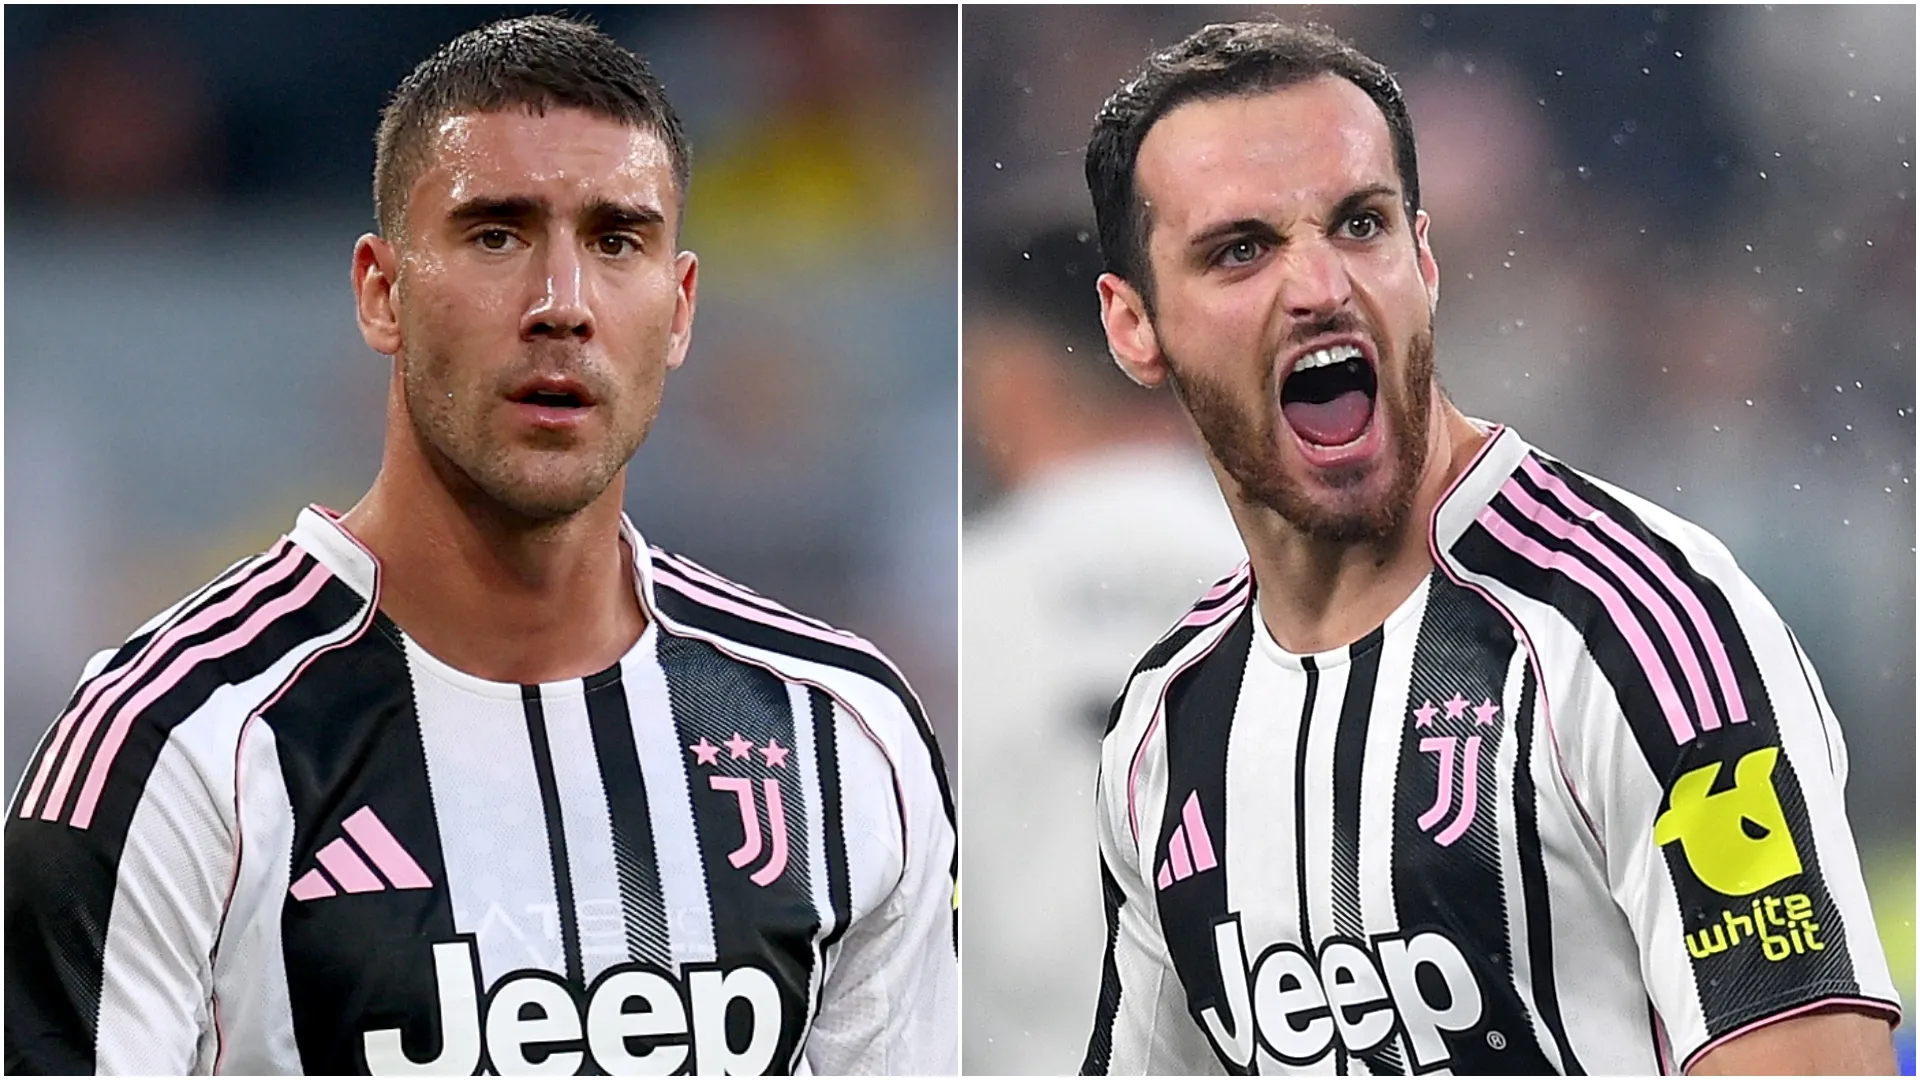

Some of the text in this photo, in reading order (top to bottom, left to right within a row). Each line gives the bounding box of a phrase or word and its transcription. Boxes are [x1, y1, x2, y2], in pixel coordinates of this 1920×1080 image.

[1685, 893, 1814, 959] white
[1761, 920, 1825, 962] bit
[363, 941, 783, 1076] Jeep
[1200, 920, 1483, 1068] Jeep
